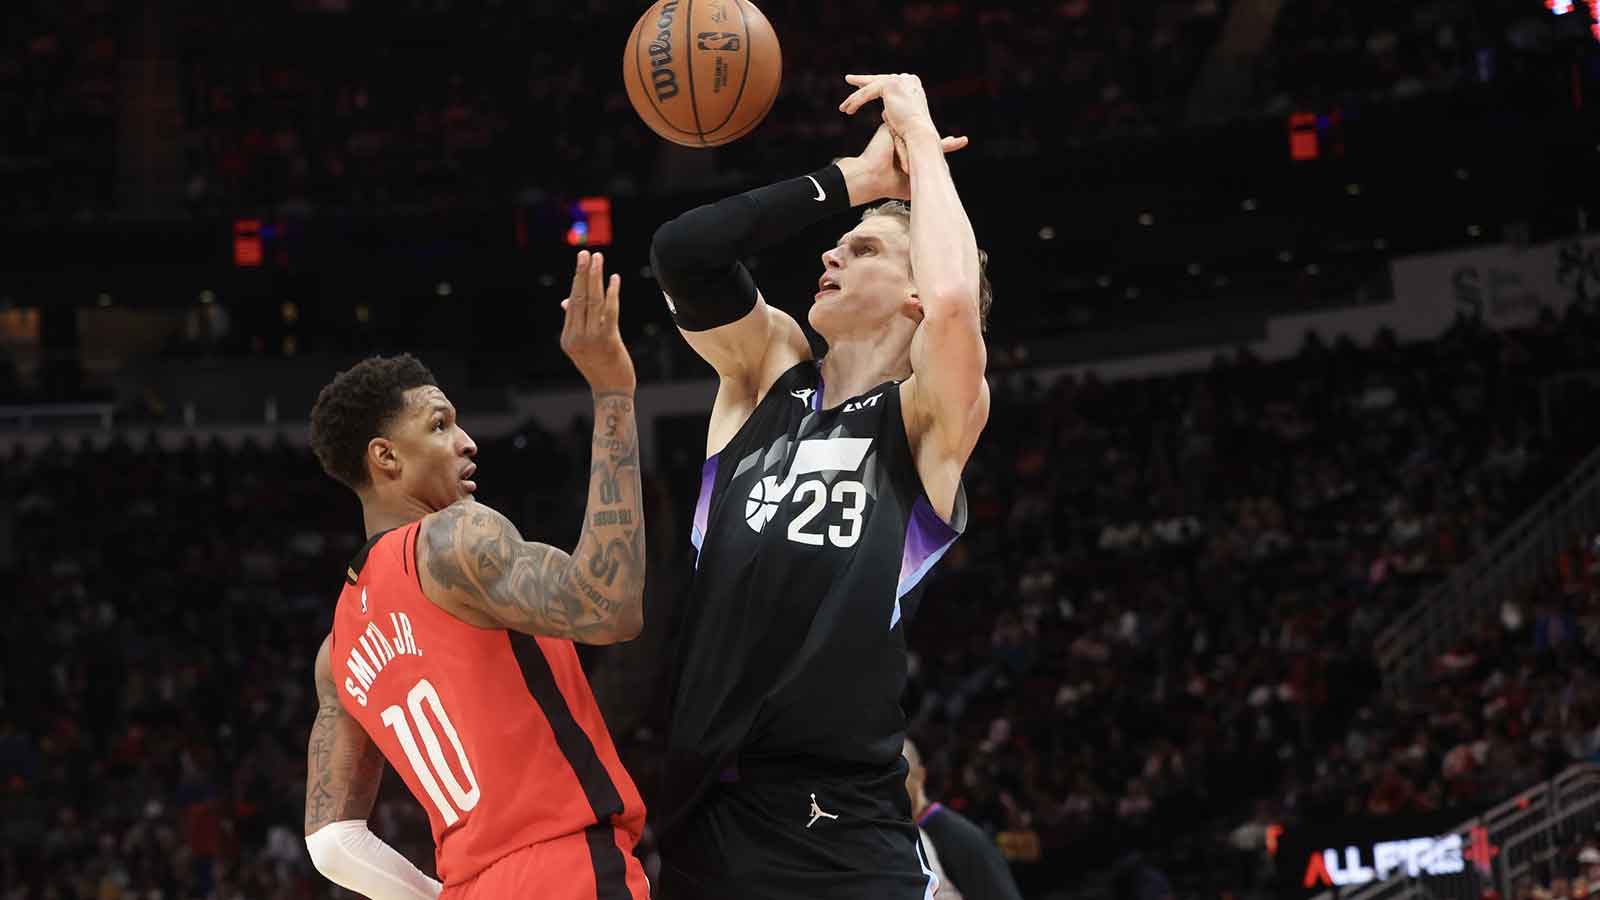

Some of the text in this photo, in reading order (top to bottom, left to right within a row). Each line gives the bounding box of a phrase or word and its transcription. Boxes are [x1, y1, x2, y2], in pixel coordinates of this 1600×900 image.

[649, 0, 679, 103] Wilson
[787, 479, 867, 548] 23
[389, 611, 423, 657] JR.
[380, 678, 481, 827] 10
